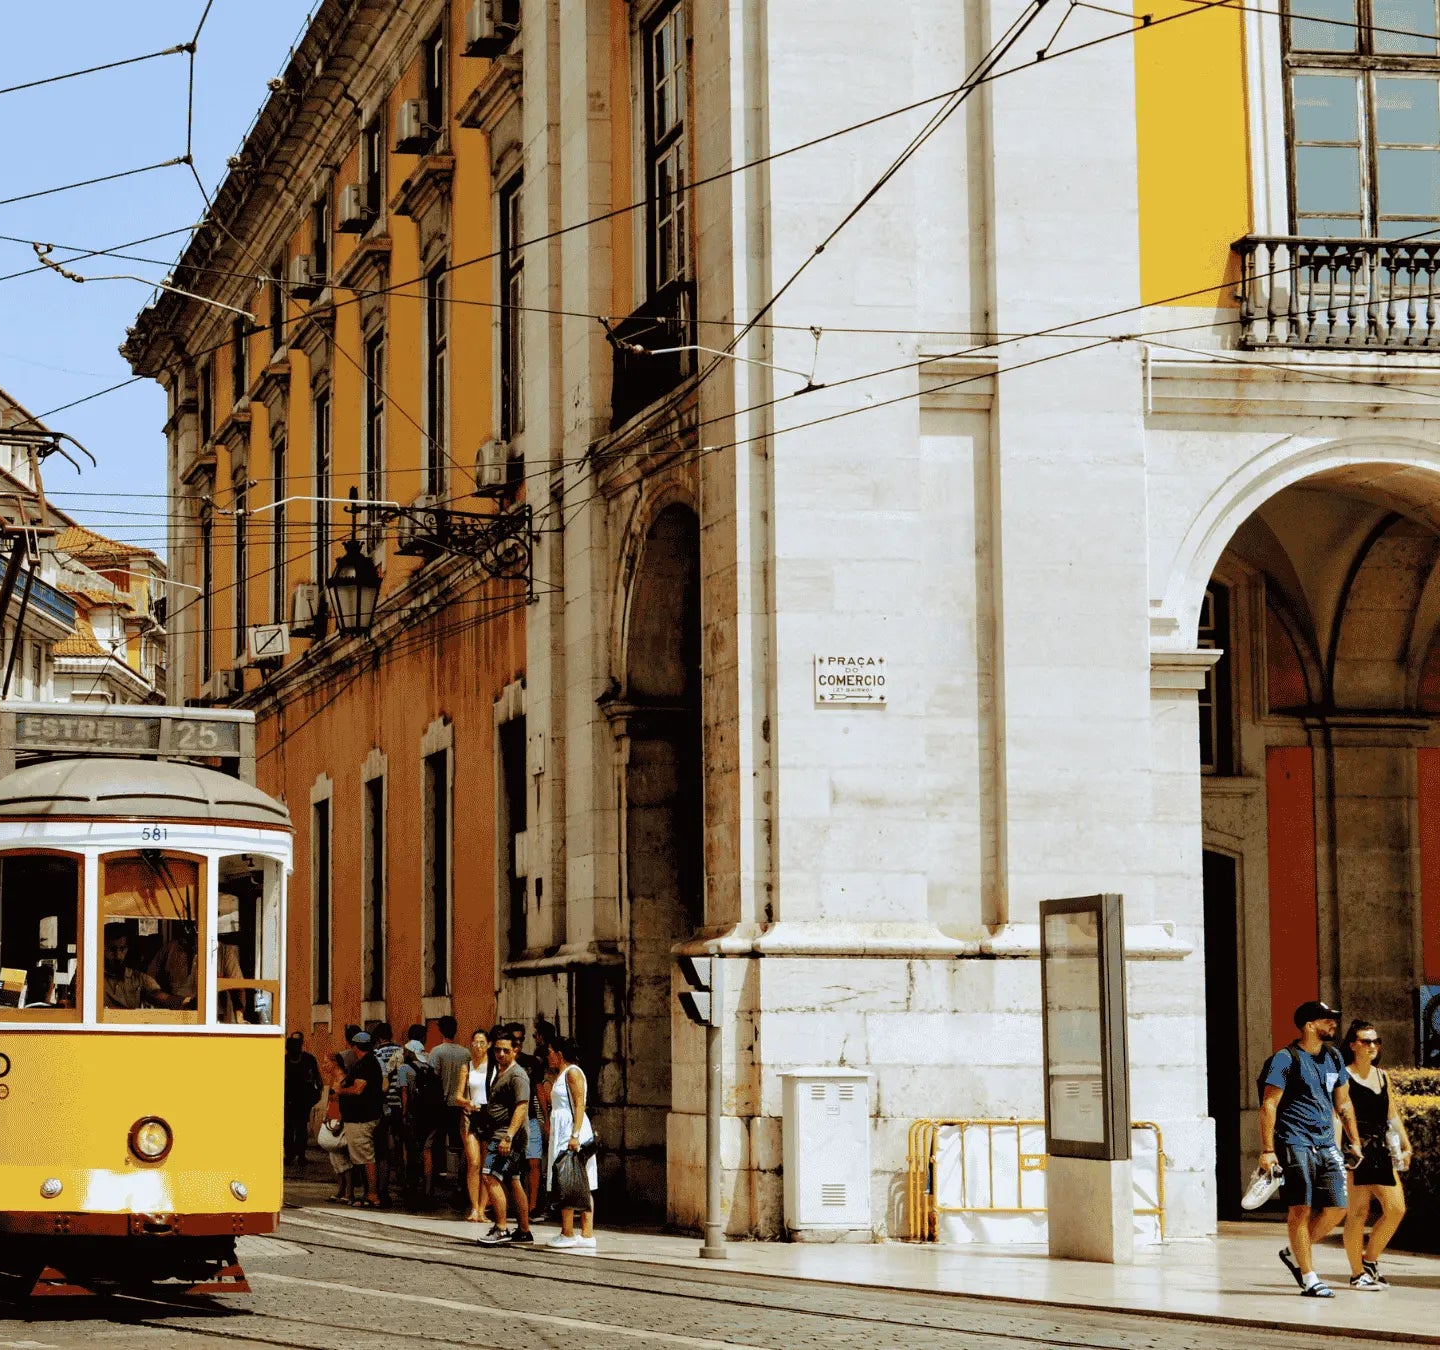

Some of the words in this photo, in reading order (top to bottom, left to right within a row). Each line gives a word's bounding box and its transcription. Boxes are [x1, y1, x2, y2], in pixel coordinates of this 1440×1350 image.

[828, 657, 875, 668] PRAÇA
[819, 675, 885, 686] COMERCIO
[24, 717, 148, 740] ESTRELA
[177, 721, 218, 749] 25
[141, 827, 168, 841] 581
